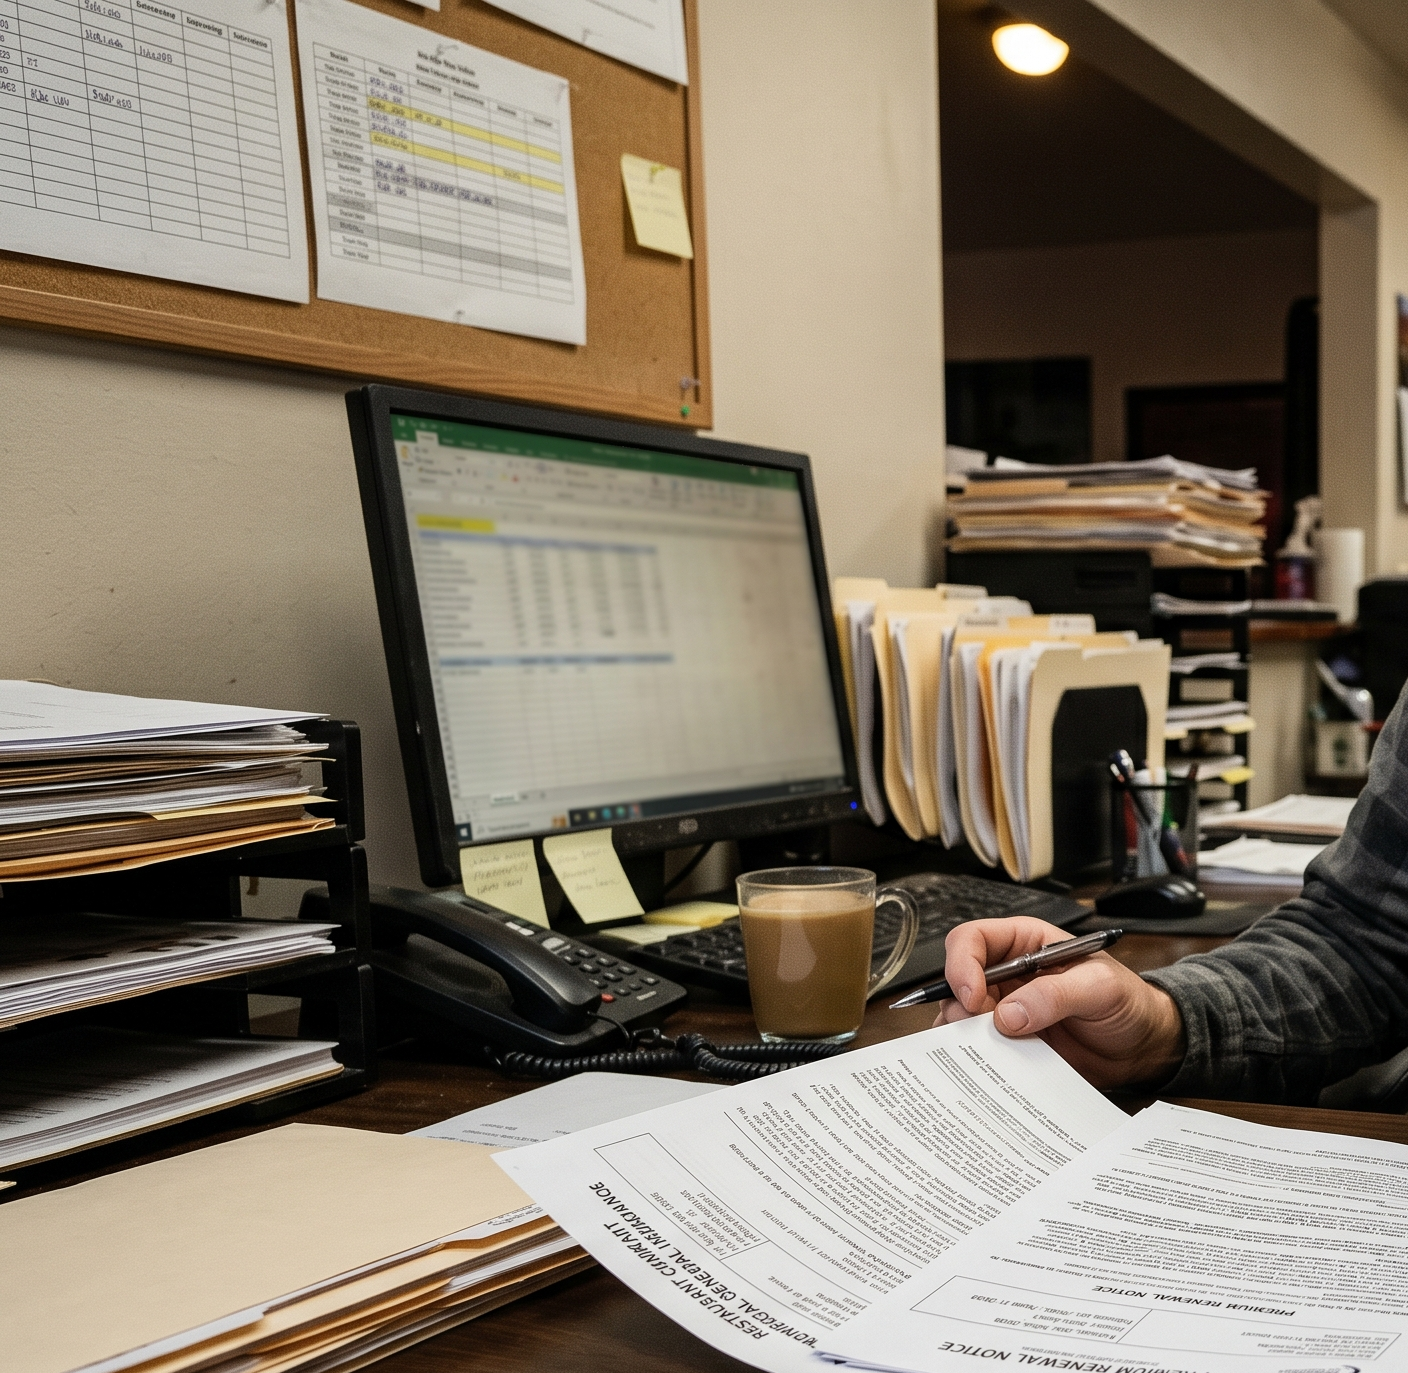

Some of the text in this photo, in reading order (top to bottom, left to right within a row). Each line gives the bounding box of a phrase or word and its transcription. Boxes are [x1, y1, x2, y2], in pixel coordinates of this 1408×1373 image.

[1091, 1284, 1148, 1298] NOTICE
[1152, 1292, 1223, 1309] RENEWAL
[937, 1341, 1015, 1362] NOTICE
[1017, 1353, 1113, 1373] RENEWAL
